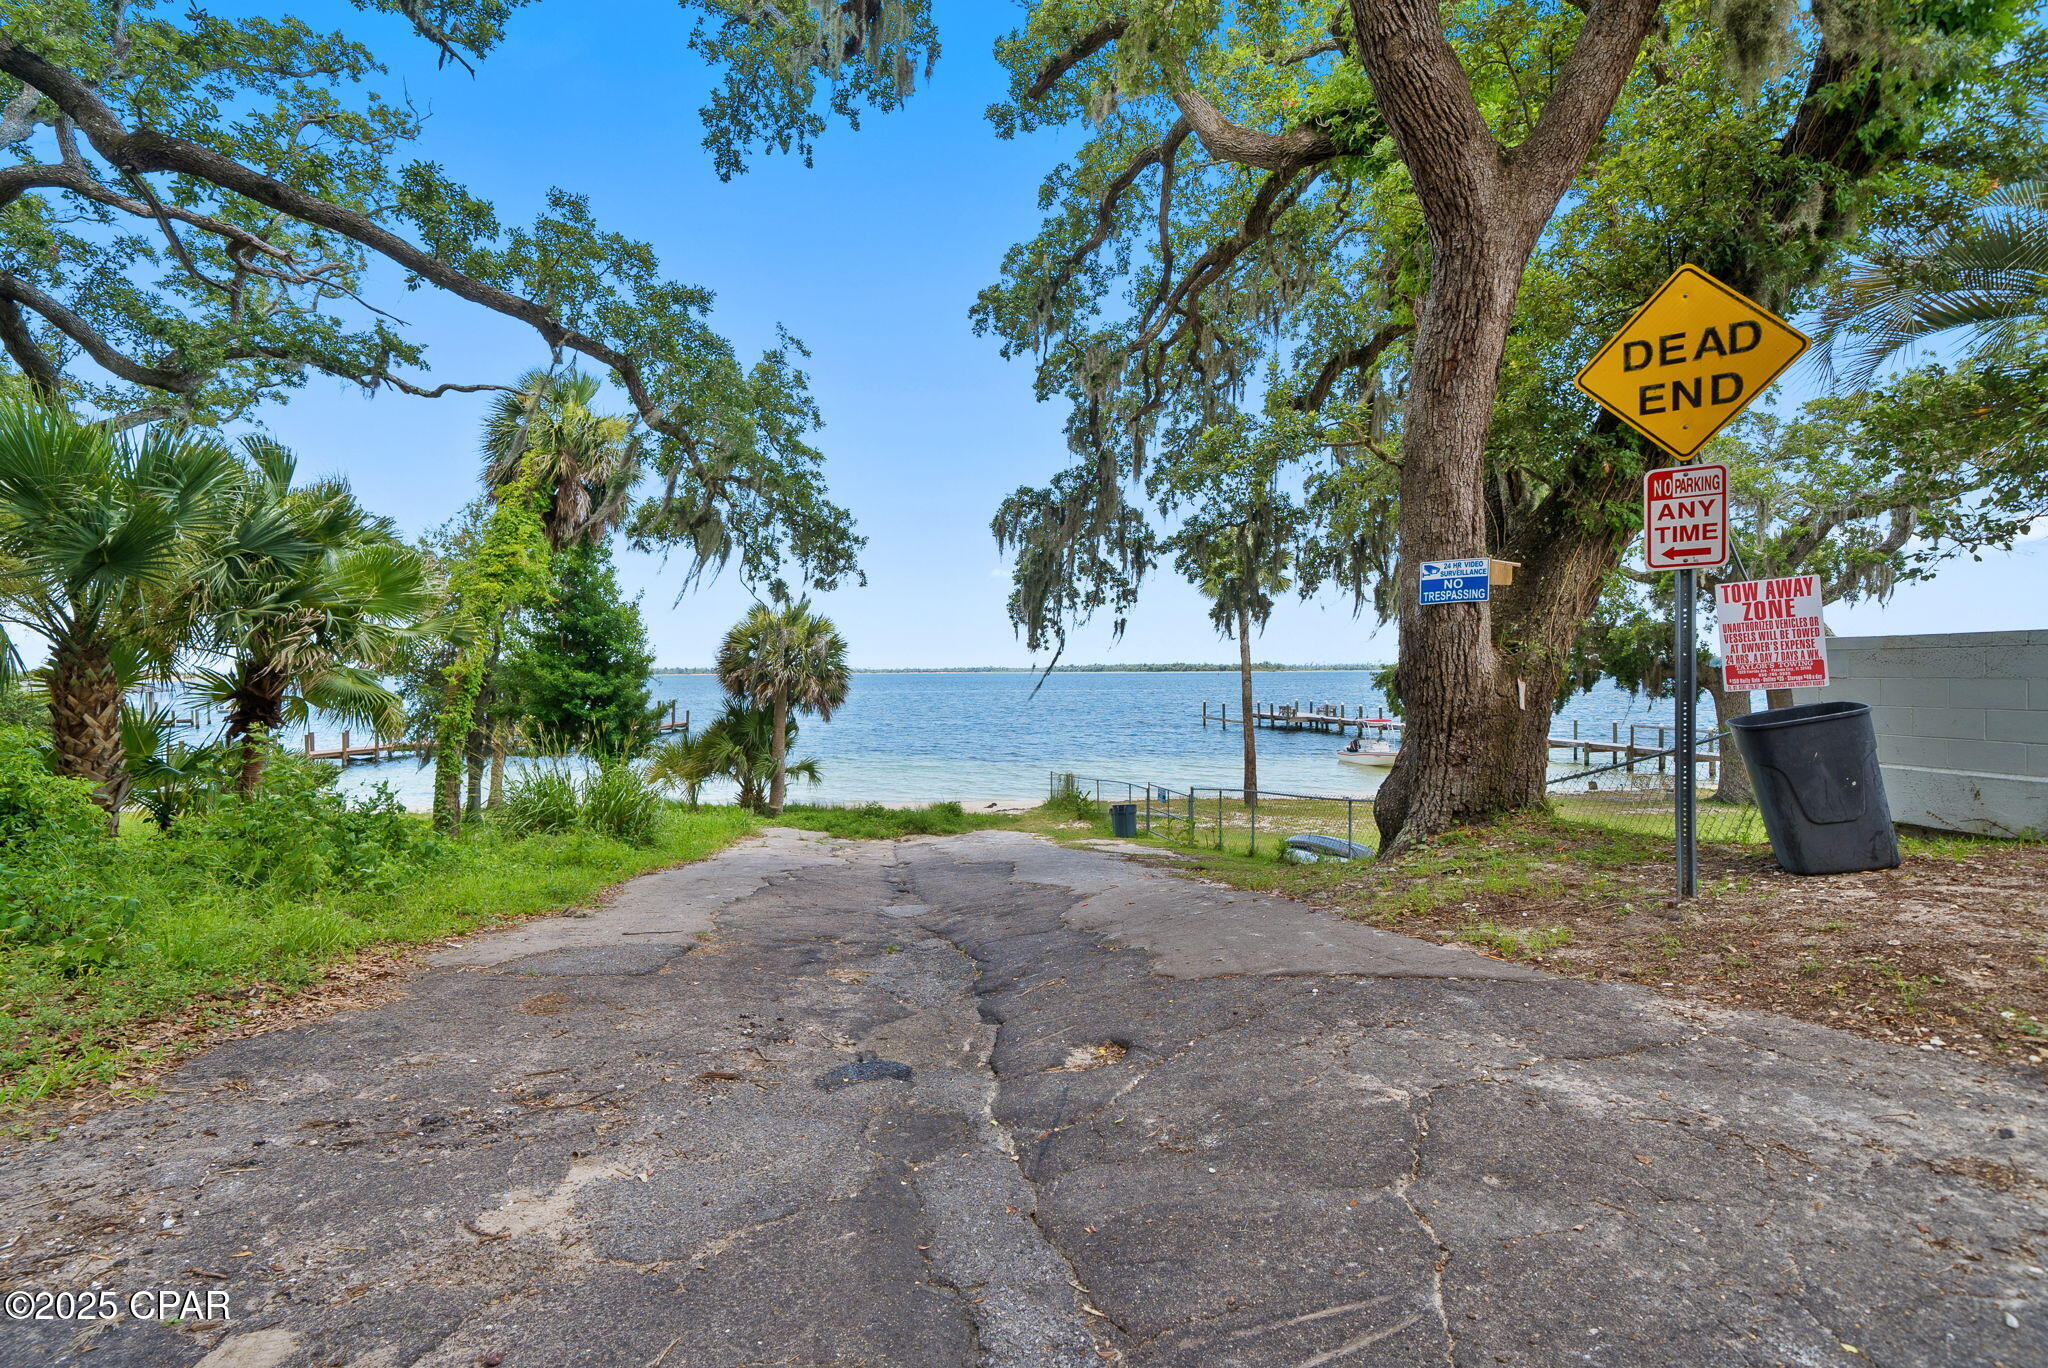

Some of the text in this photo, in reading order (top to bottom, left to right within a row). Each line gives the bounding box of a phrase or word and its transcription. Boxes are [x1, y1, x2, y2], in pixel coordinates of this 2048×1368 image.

[1622, 320, 1763, 372] DEAD
[1639, 372, 1744, 416] END
[1653, 474, 1720, 497] NO PARKING
[1657, 499, 1716, 520] ANY
[1654, 522, 1718, 543] TIME
[1440, 568, 1487, 577] SURVEILLANCE
[1443, 578, 1463, 589] NO
[1721, 576, 1813, 604] TOW AWAY
[1423, 589, 1485, 602] TRESPASSING
[1742, 598, 1796, 621] ZONE
[1722, 616, 1819, 633] UNAUTHORIZED VEHICLES OR
[1724, 627, 1820, 644] VESSELS WILL BE TOWED
[1730, 639, 1816, 654] AT OWNER'S EXPENSE
[1725, 649, 1822, 665] 24 HRS. A DAY 7 DAYS A WK.
[1735, 662, 1775, 670] TAYLOR'S
[1778, 660, 1813, 668] TOWING
